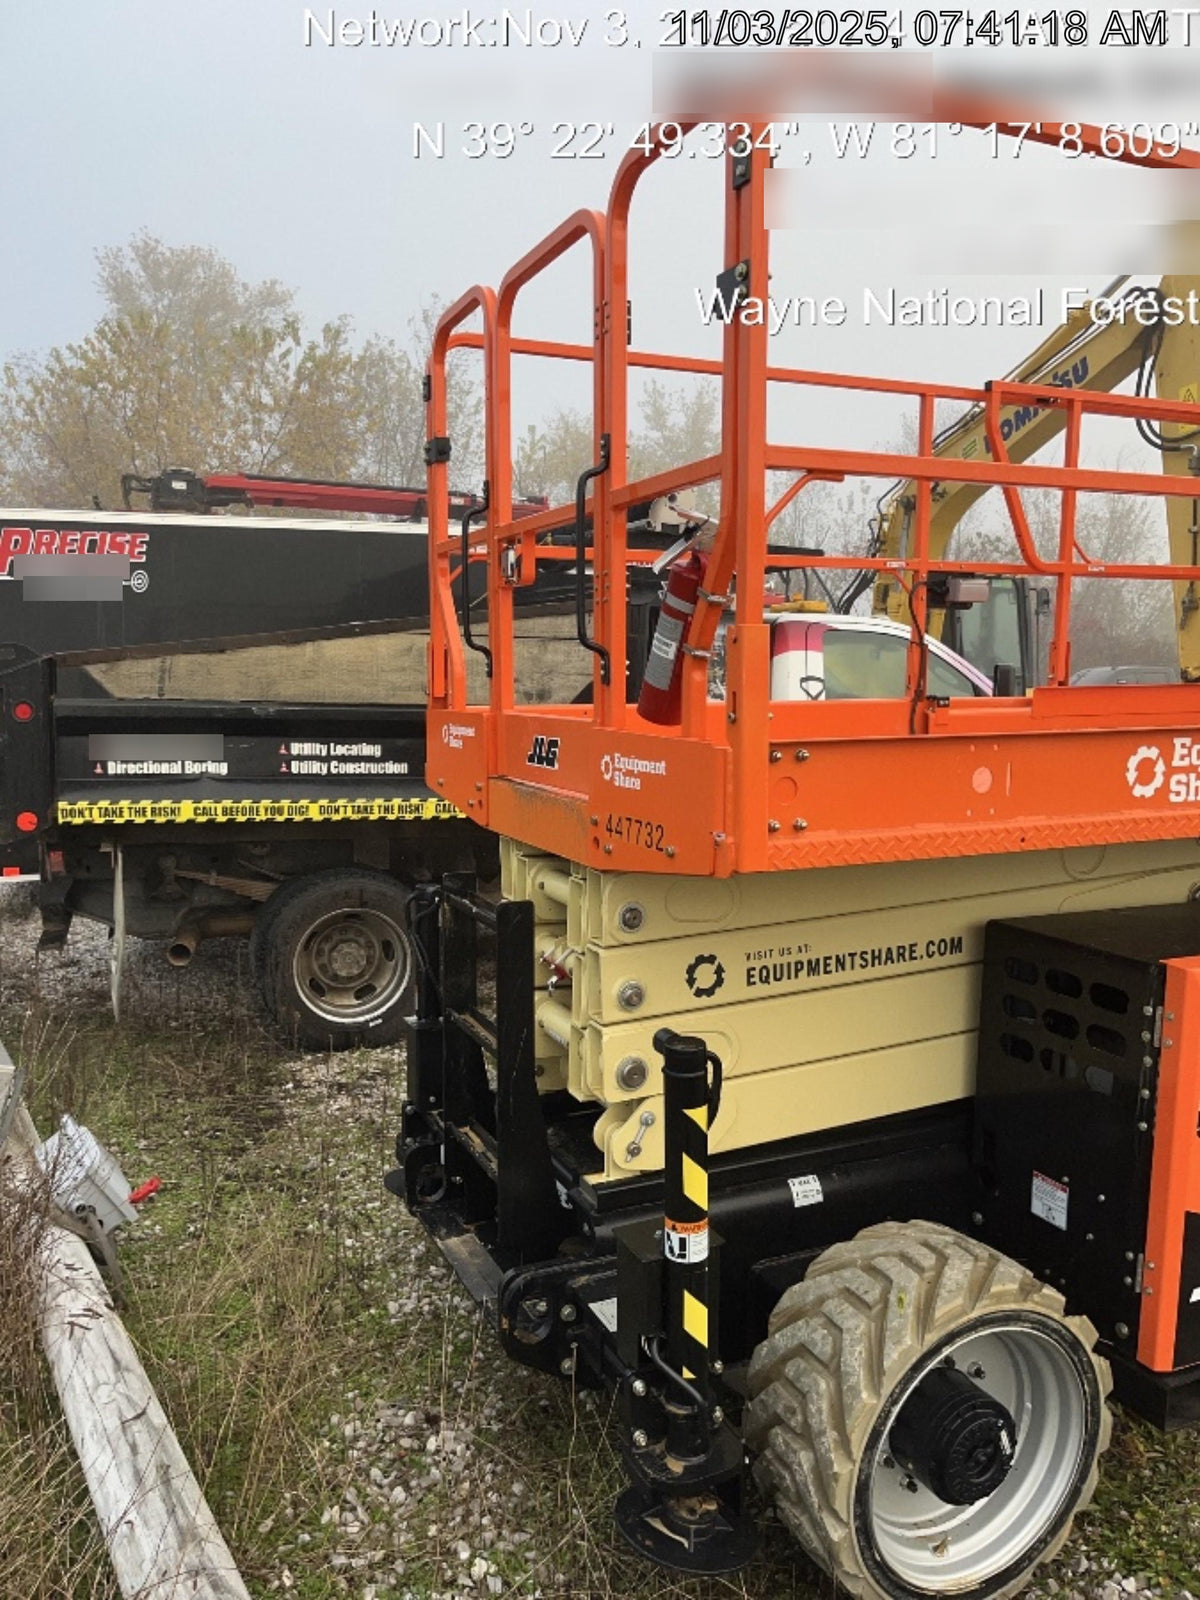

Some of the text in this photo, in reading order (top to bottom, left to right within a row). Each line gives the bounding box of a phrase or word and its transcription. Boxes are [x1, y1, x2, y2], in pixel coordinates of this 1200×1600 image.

[0, 526, 150, 575] PRECISE
[290, 742, 382, 758] Utility Locating
[526, 736, 560, 770] JLG
[107, 761, 228, 775] Directional Boring
[291, 761, 408, 776] Utility Construction
[614, 753, 667, 776] Equipment
[613, 771, 641, 790] Share
[60, 806, 94, 819] DON'T
[97, 806, 125, 818] TAKE
[127, 806, 148, 818] THE
[150, 806, 181, 818] RISK!
[193, 805, 219, 817] CALL
[221, 805, 262, 817] BEFORE
[264, 805, 284, 817] YOU
[319, 804, 348, 816] DON'T
[351, 804, 375, 815] TAKE
[377, 804, 395, 815] THE
[606, 814, 664, 852] 447732
[744, 948, 774, 961] VISIT
[778, 947, 792, 957] US
[746, 936, 964, 987] EQUIPMENTSHARE.COM
